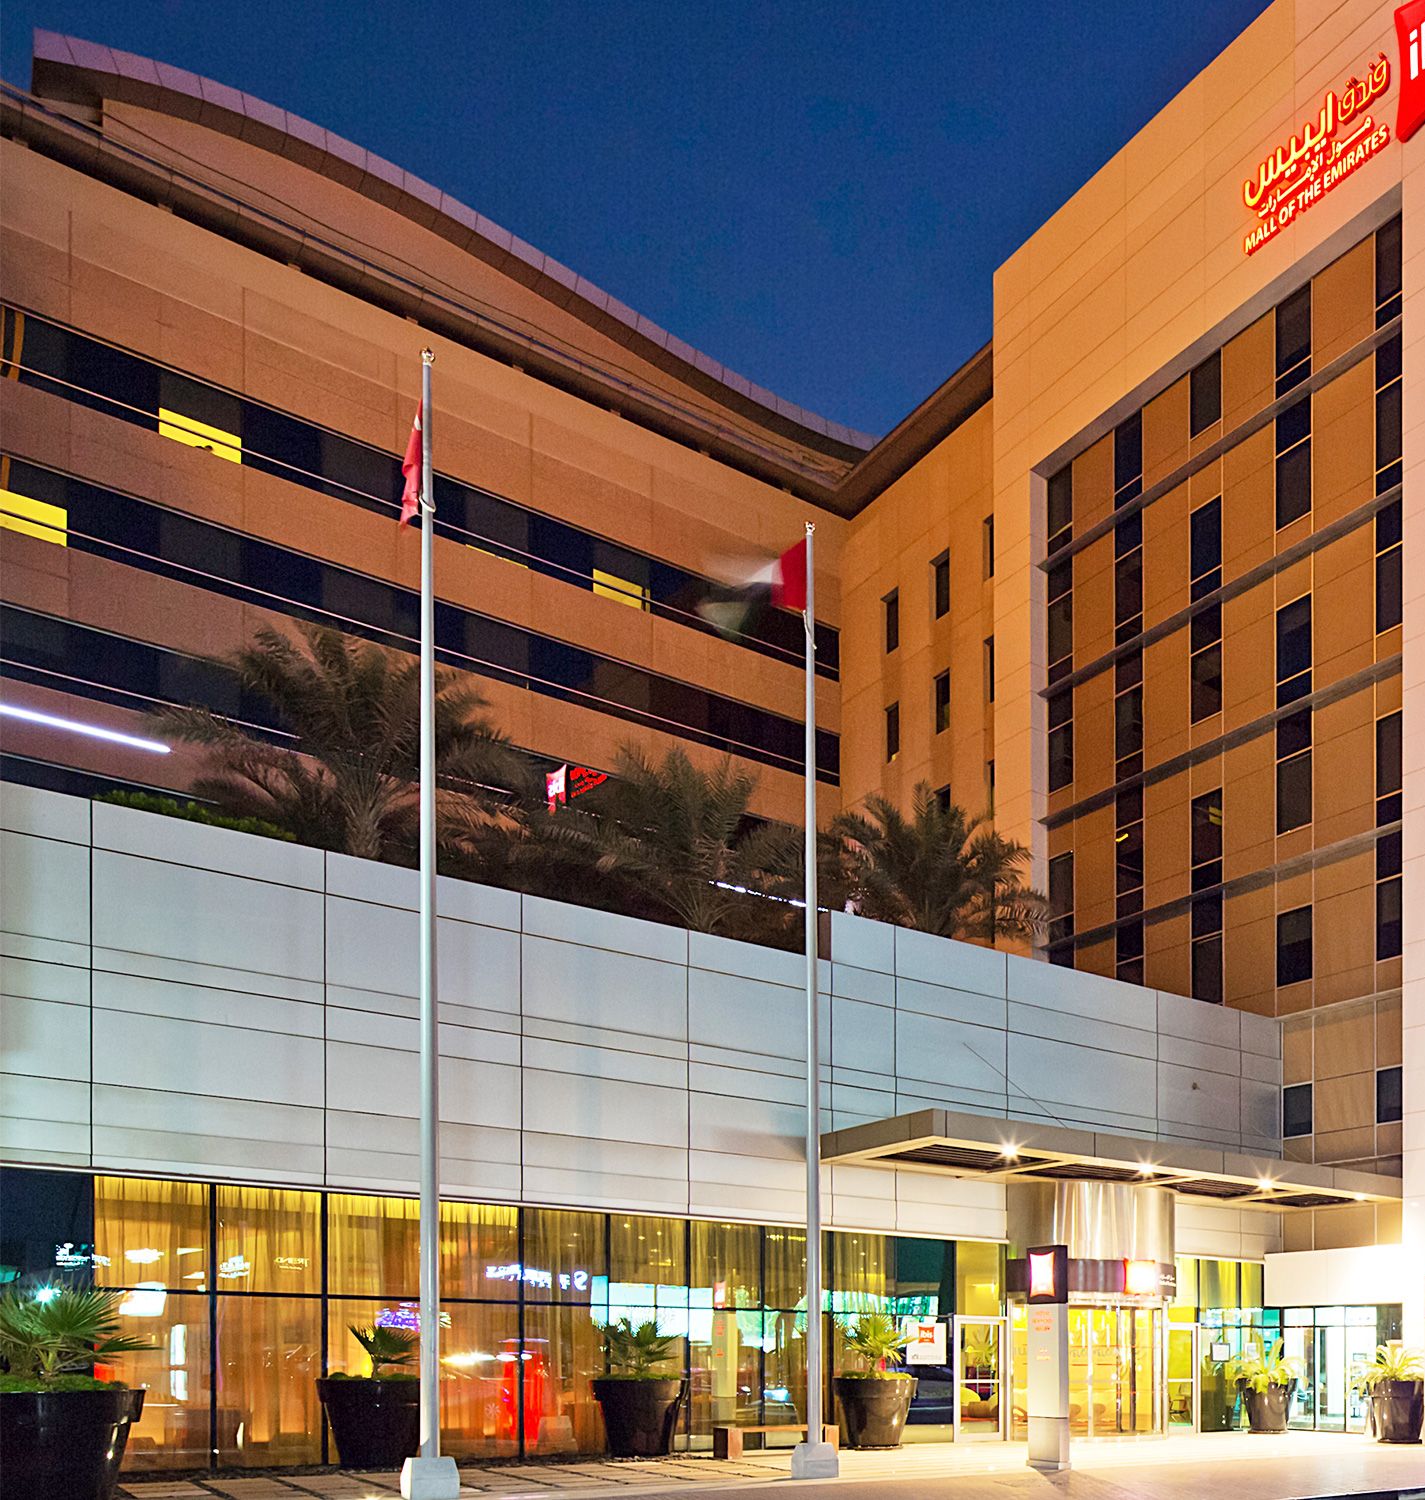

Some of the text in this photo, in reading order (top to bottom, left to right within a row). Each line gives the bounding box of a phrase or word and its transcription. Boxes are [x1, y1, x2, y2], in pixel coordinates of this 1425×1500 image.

[1338, 53, 1388, 121] فندق
[1327, 115, 1372, 165] مول
[1245, 124, 1388, 253] MALL OF THE EMIRATES
